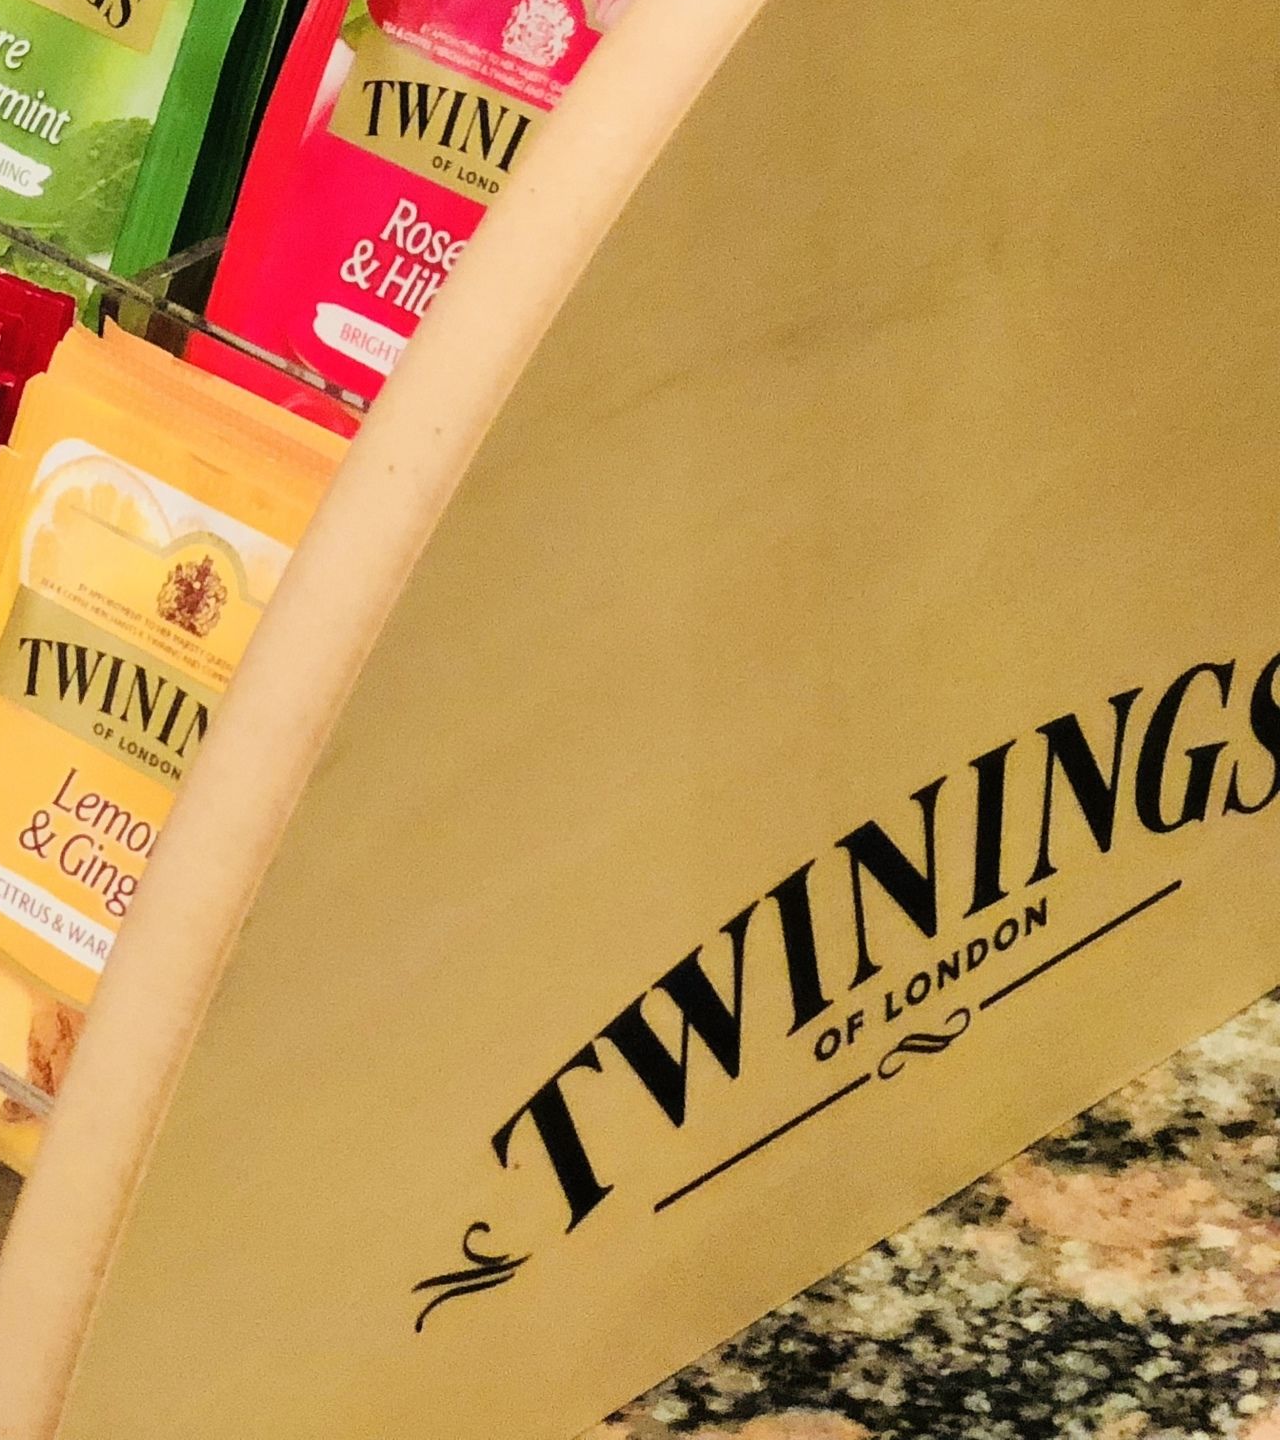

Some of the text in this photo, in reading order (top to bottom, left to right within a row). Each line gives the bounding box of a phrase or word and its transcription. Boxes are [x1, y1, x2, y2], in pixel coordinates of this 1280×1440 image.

[363, 80, 532, 174] TWINI
[432, 155, 500, 195] OF LOND
[340, 239, 381, 290] &
[379, 198, 469, 272] Rose
[340, 322, 401, 365] BRIGHT
[93, 722, 183, 781] OF LONDON
[18, 809, 139, 917] & Ging
[51, 913, 65, 935] &
[68, 920, 109, 960] WAR
[490, 651, 1280, 1234] TWININGS
[813, 897, 1049, 1063] OF LONDON
